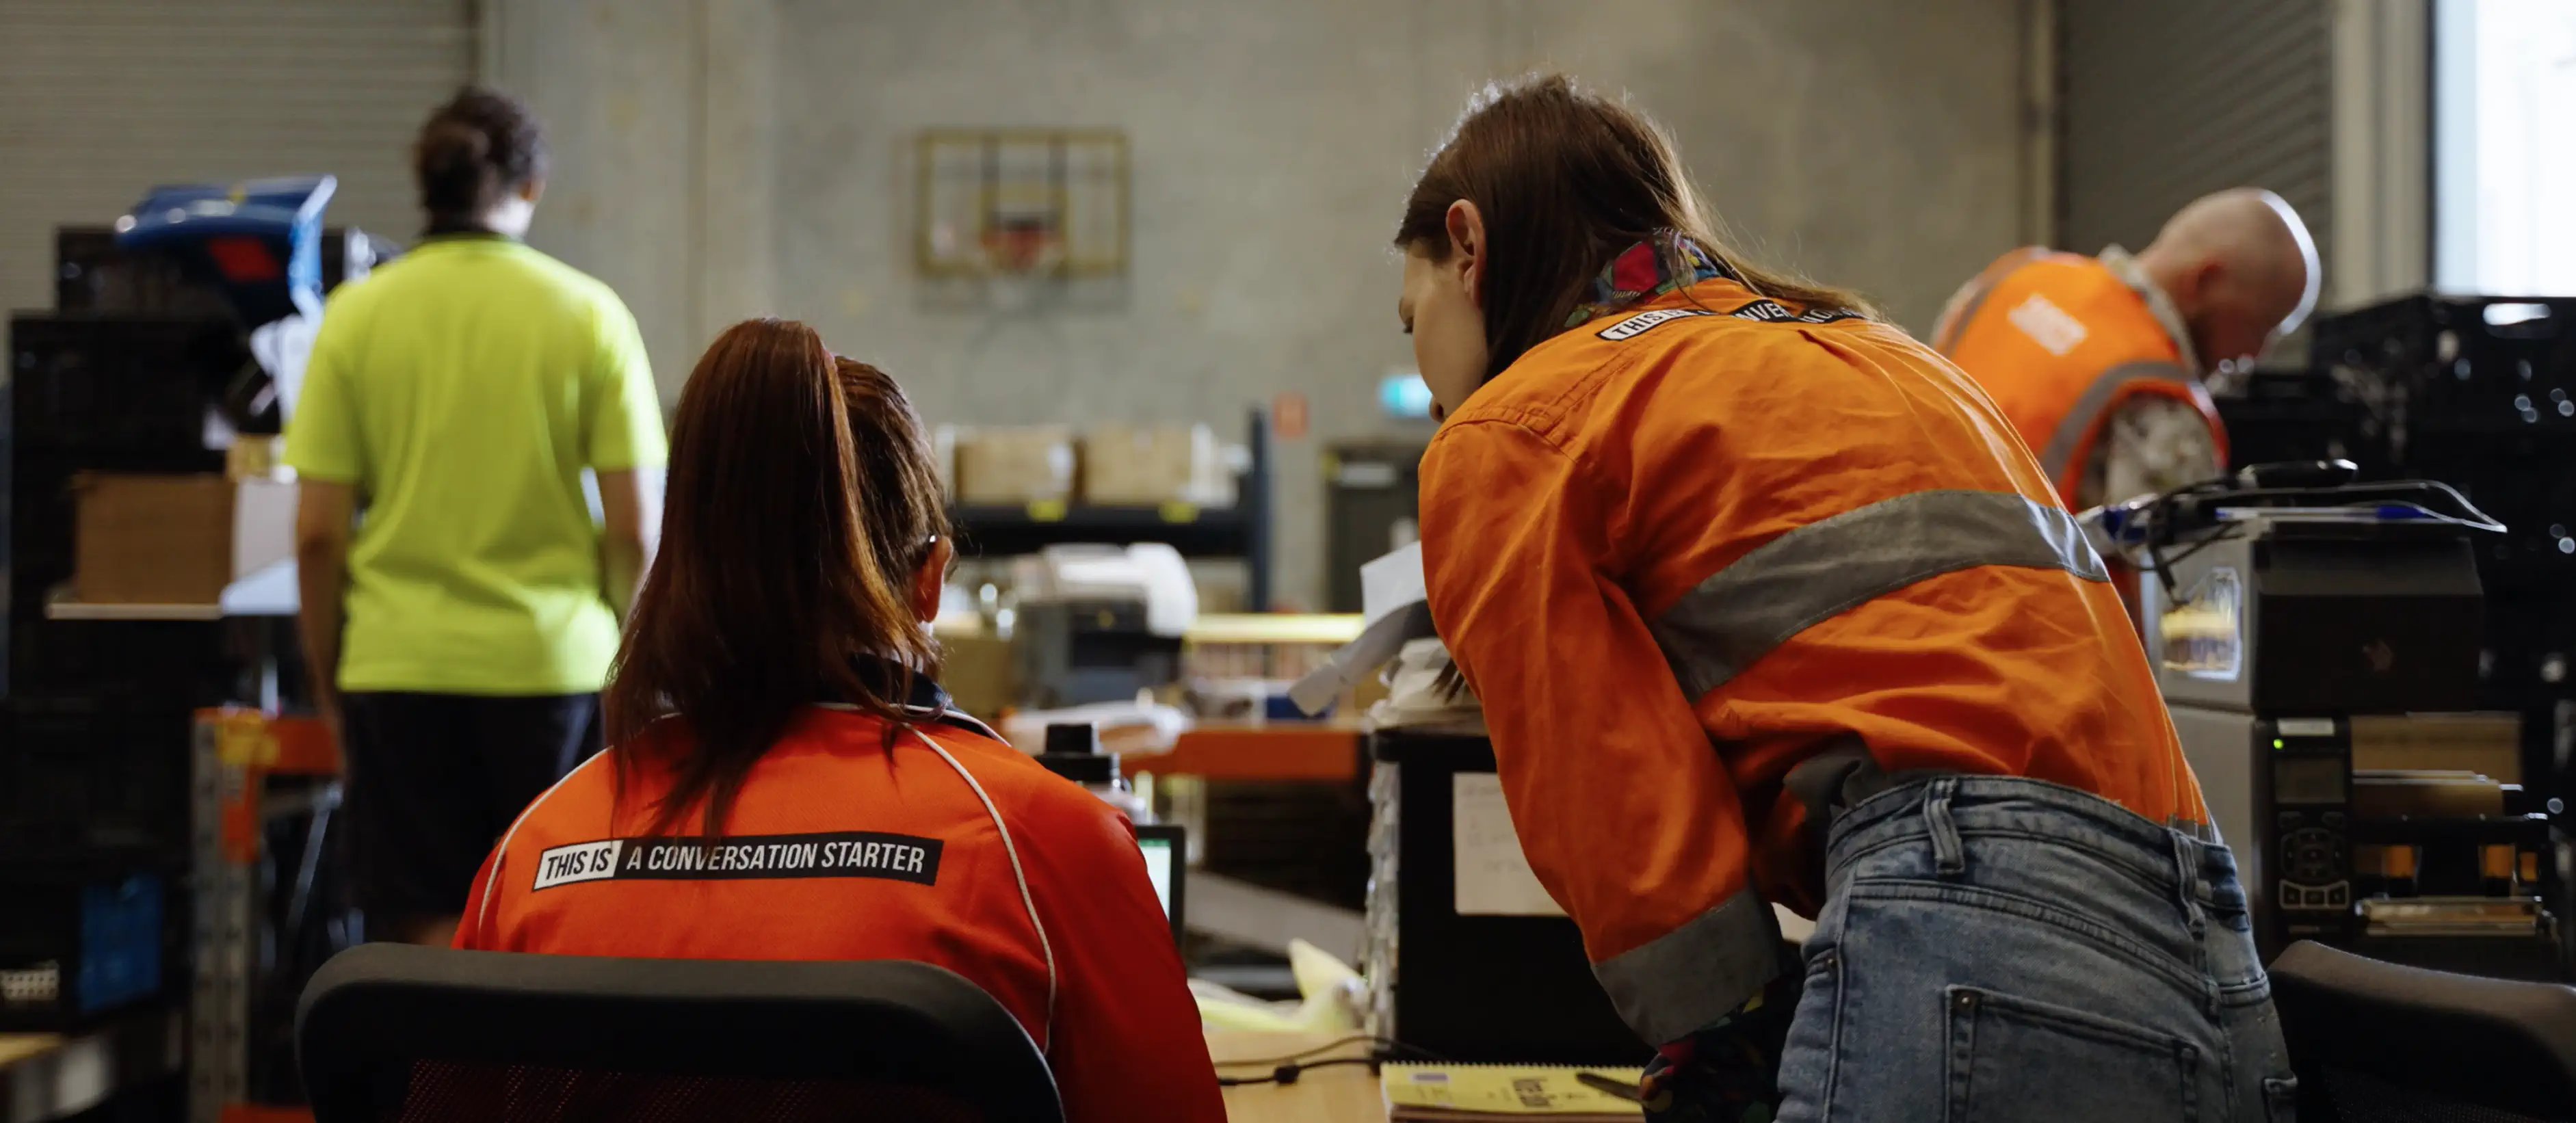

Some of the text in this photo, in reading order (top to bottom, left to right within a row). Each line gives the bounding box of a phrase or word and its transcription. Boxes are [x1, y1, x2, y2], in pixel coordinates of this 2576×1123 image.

[1612, 313, 1663, 336] THIS
[547, 841, 926, 880] THIS IS A CONVERSATION STARTER
